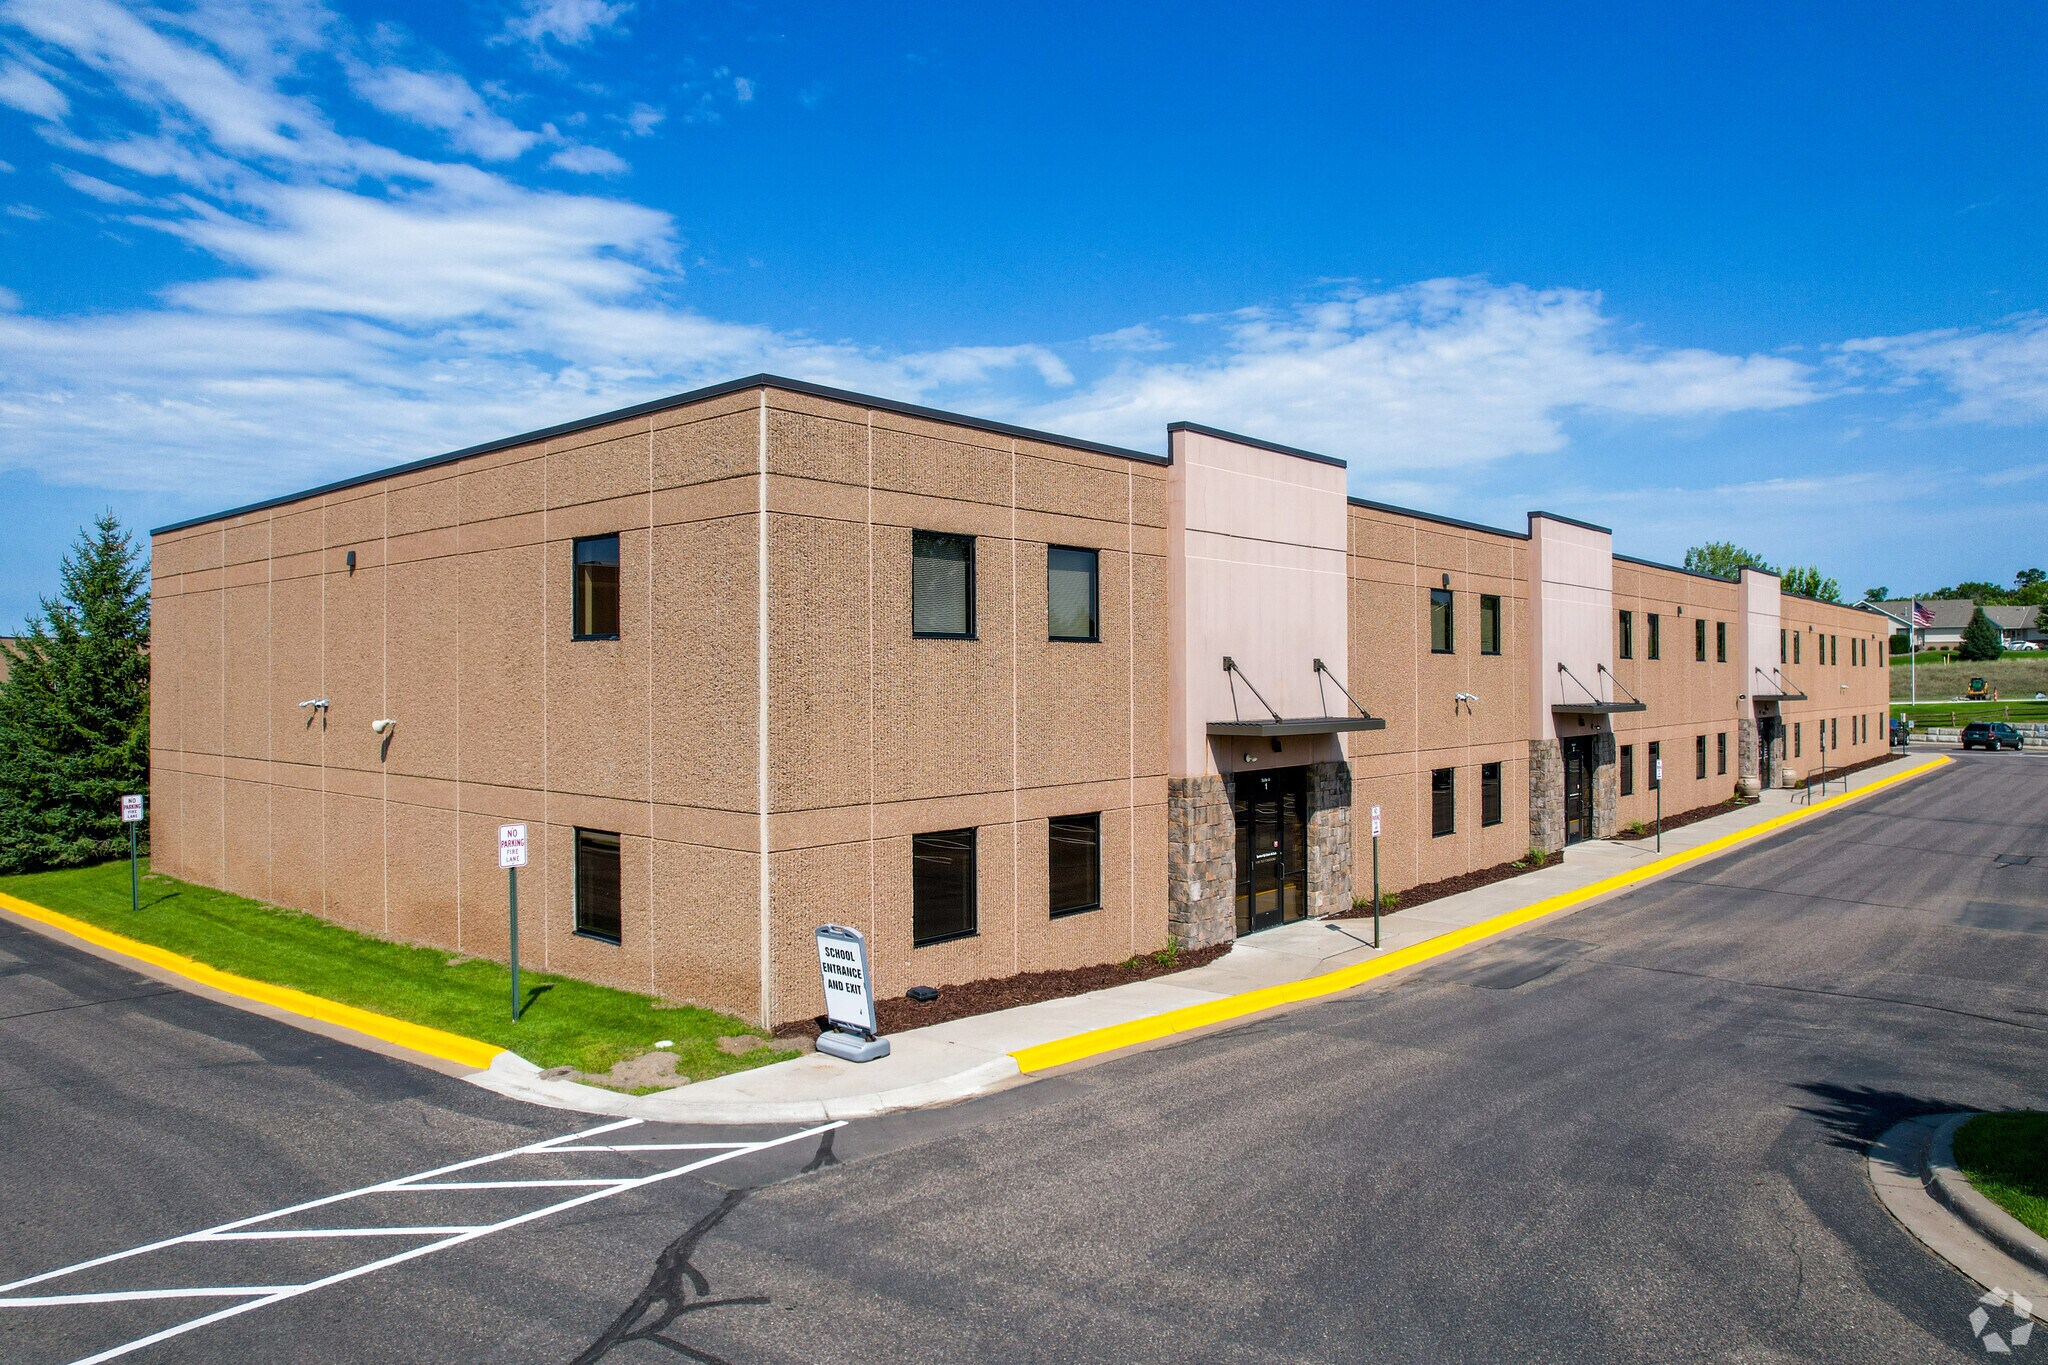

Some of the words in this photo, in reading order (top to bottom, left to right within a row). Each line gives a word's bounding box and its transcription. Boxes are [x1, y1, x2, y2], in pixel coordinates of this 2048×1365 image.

[507, 829, 518, 838] NO
[501, 838, 525, 848] PARKING
[506, 855, 520, 863] LANE
[824, 946, 856, 962] SCHOOL
[822, 962, 863, 980] ENTRANCE
[828, 979, 844, 991] AND
[846, 983, 862, 995] EXIT
